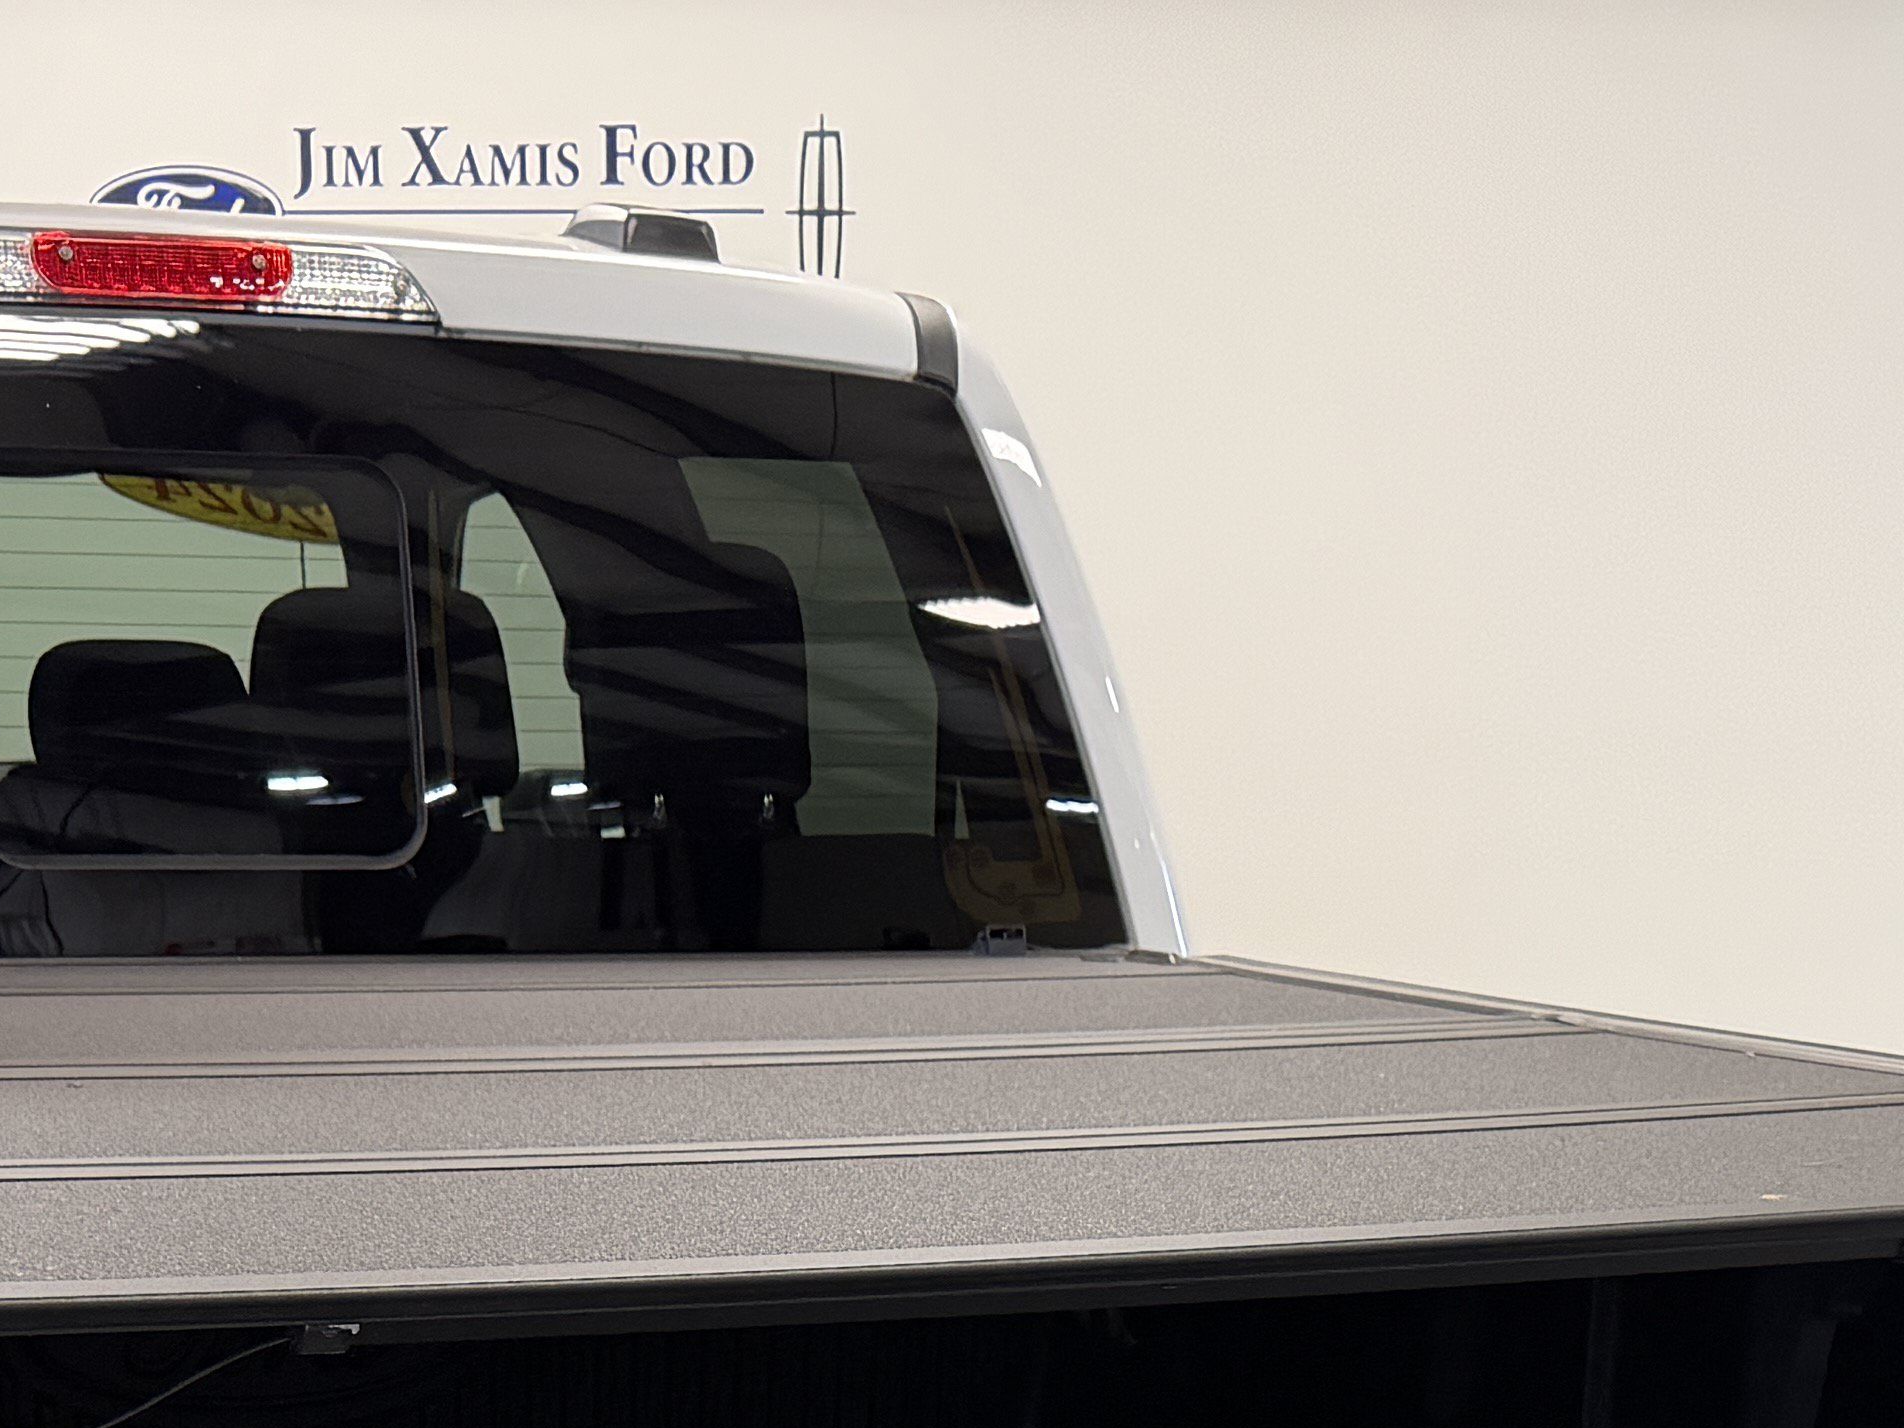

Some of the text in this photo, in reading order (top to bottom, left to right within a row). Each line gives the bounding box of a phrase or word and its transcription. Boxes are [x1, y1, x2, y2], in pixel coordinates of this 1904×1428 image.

[293, 127, 383, 200] JIM
[400, 126, 580, 188] XAMIS
[598, 124, 755, 187] FORD
